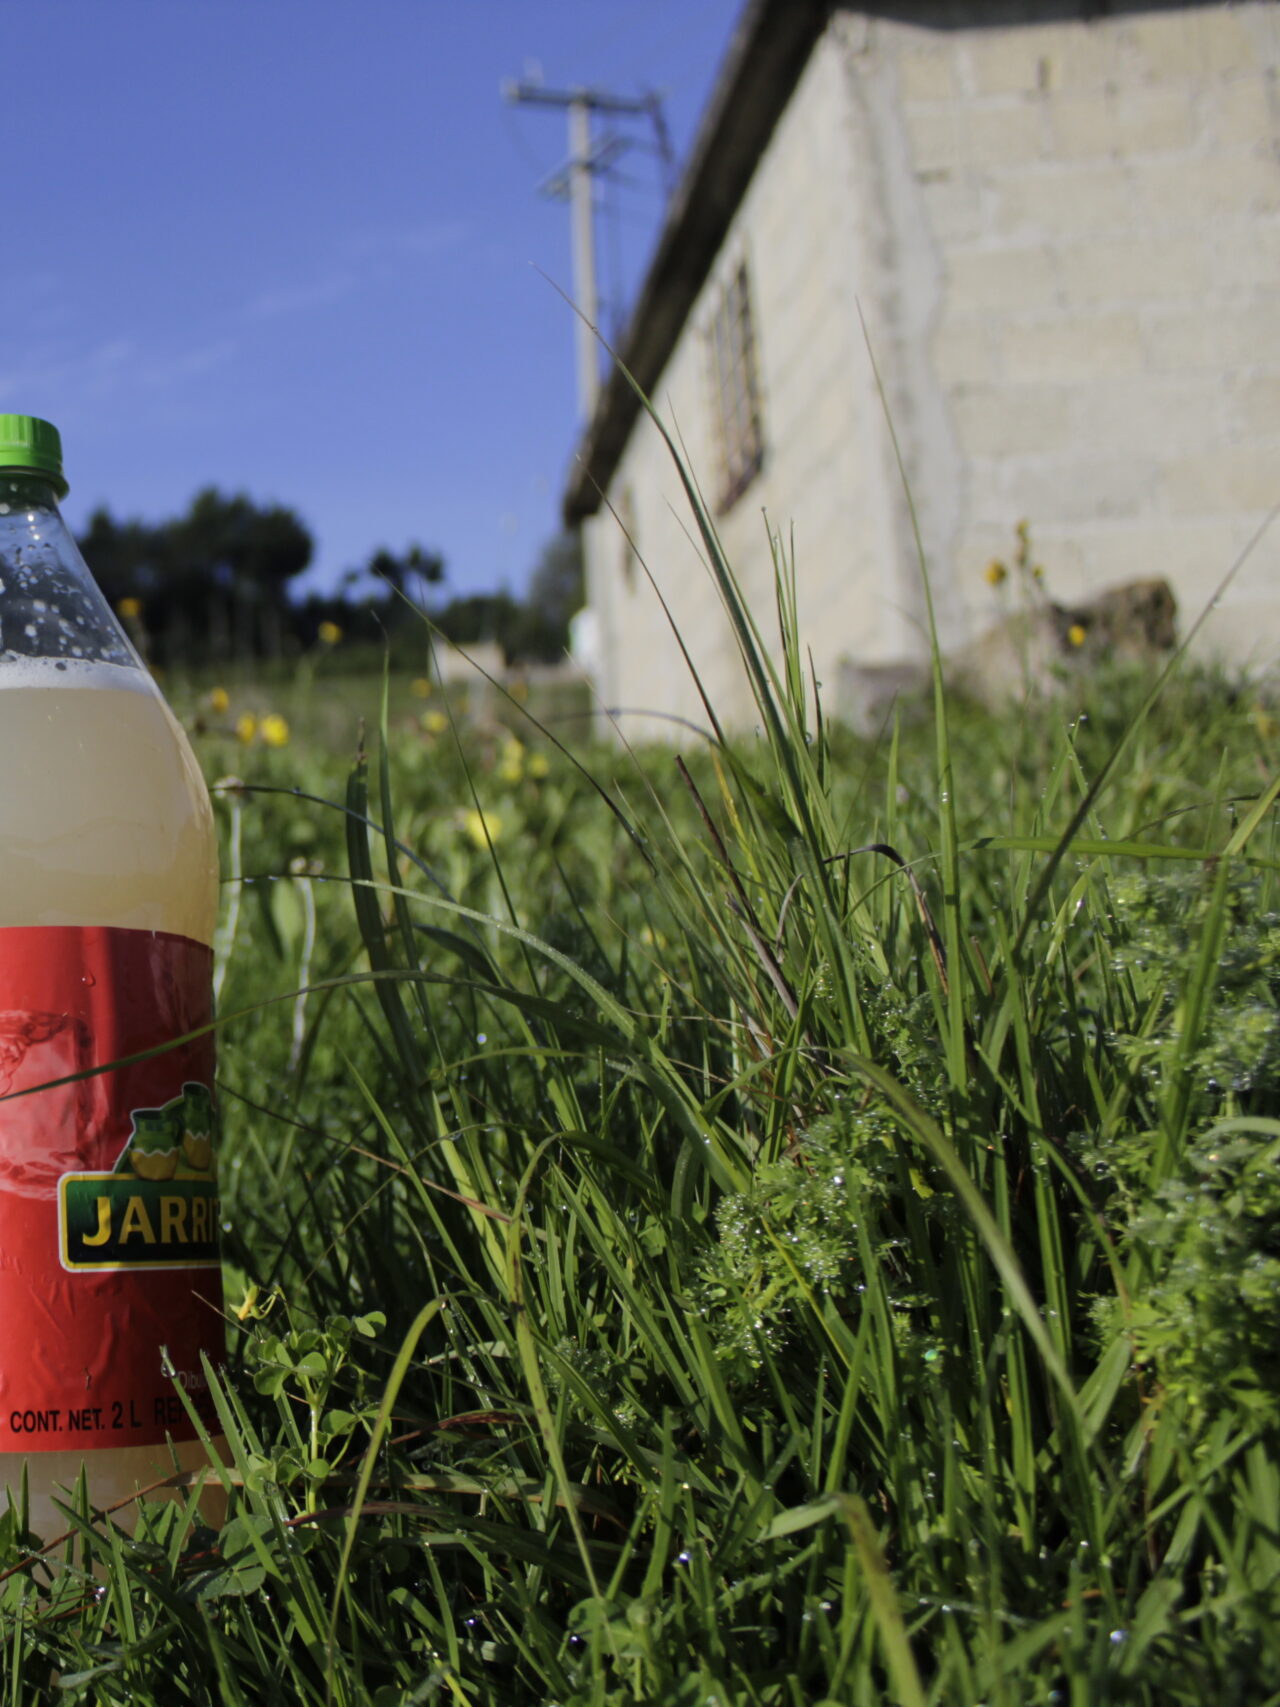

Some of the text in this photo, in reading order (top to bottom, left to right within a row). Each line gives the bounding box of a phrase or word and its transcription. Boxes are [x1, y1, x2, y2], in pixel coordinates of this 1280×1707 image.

[9, 1409, 63, 1434] CONT.
[68, 1407, 105, 1432] NET.
[111, 1400, 124, 1429] 2
[129, 1399, 143, 1428] L
